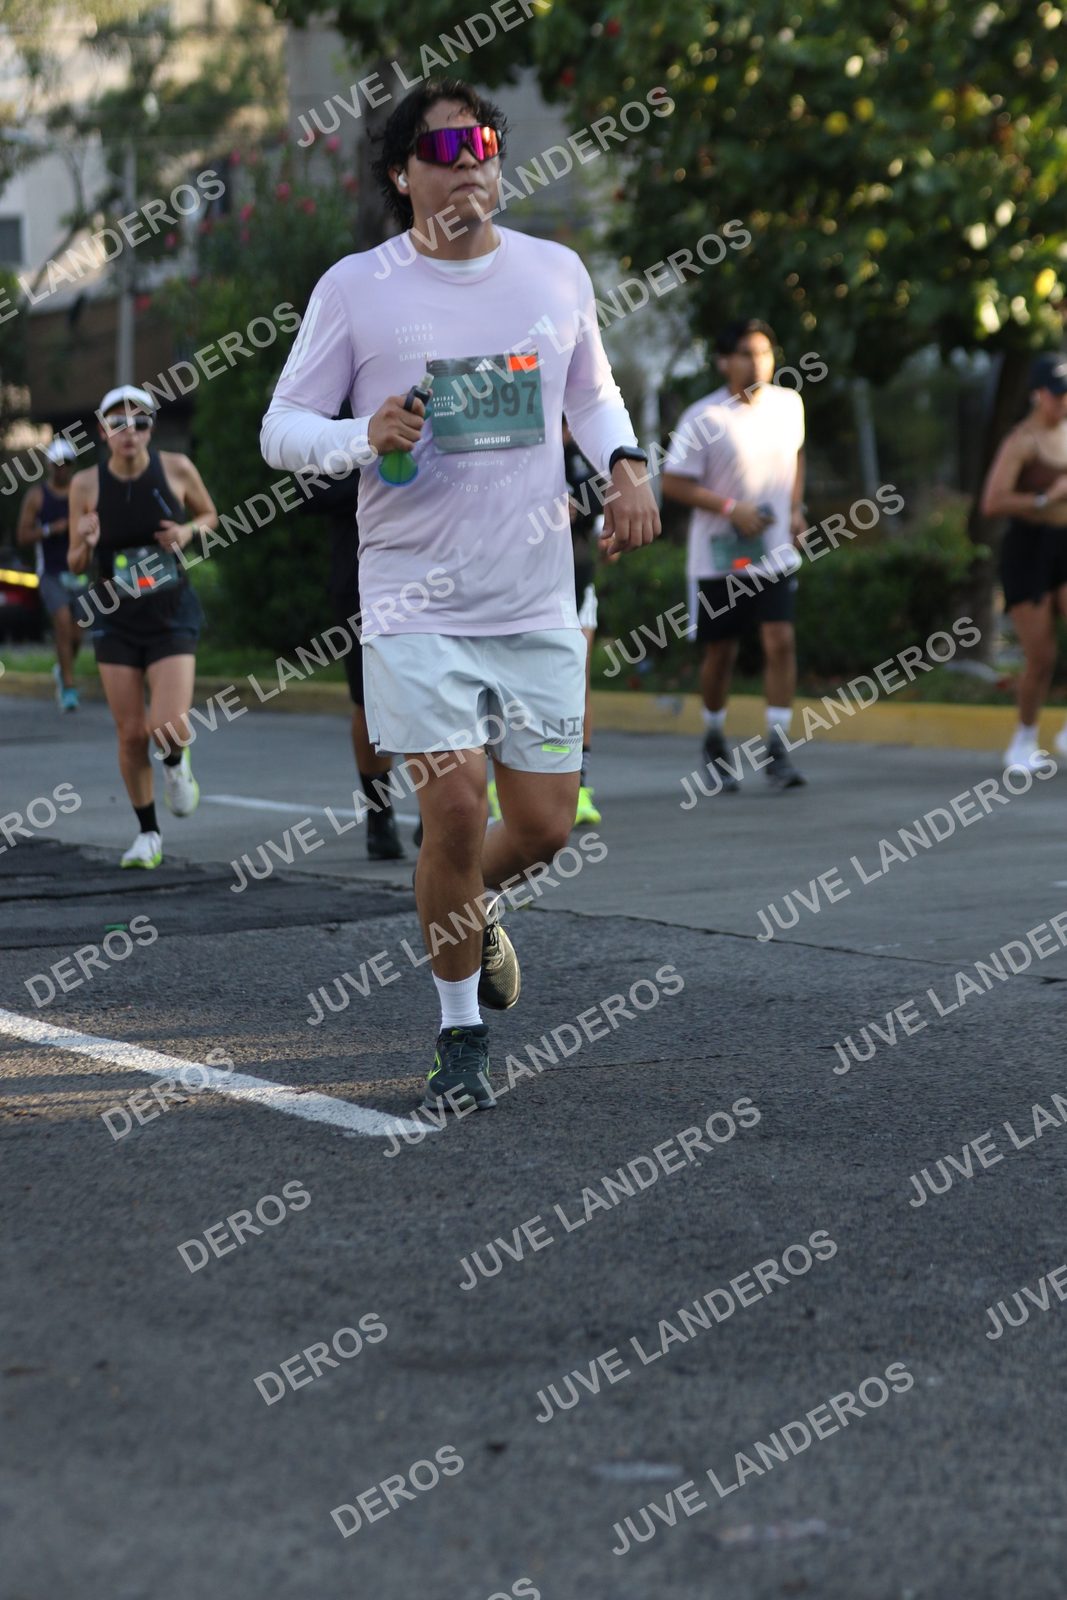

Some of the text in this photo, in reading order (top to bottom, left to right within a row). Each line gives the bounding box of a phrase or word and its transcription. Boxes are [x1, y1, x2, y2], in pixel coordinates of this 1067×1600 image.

[463, 381, 538, 420] 0997
[474, 436, 511, 446] SAMSUNG
[541, 716, 583, 736] NI
